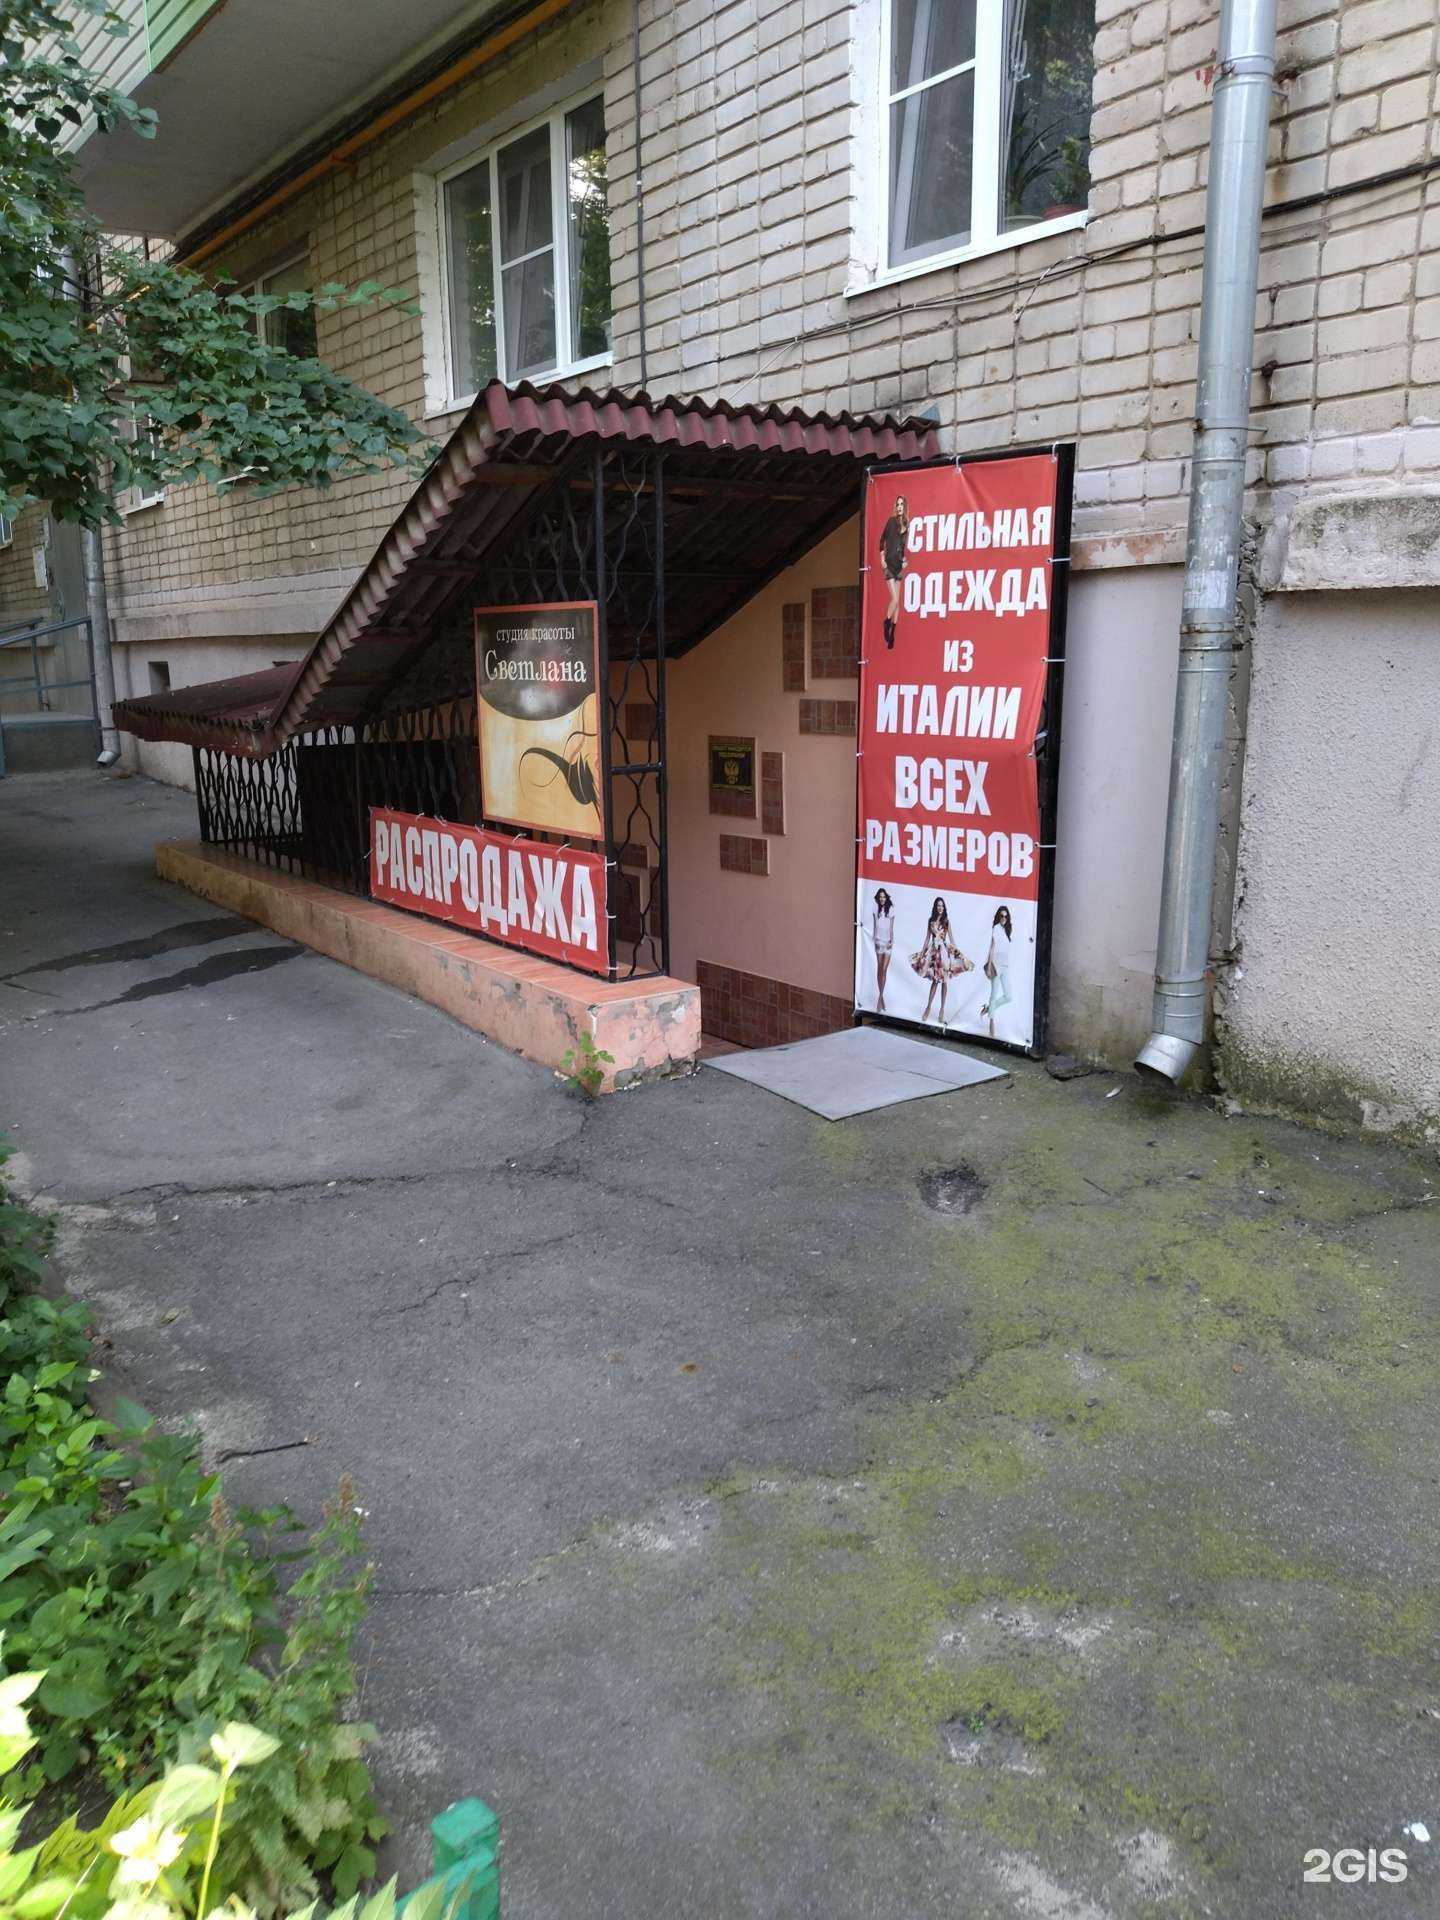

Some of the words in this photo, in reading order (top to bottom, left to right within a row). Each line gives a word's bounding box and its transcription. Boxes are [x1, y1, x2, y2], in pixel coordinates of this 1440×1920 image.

[907, 506, 1052, 553] СТИЛЬНАЯ
[903, 567, 1048, 618] ОДЕЖДА
[496, 628, 529, 643] студия
[532, 626, 575, 643] красоты
[943, 640, 974, 672] ИЗ
[485, 650, 586, 682] Светлана
[876, 684, 1022, 740] ИТАЛИИ
[895, 755, 992, 816] ВСЕХ
[865, 819, 1034, 878] РАЗМЕРОВ
[375, 820, 598, 951] РАСПРОДАЖА
